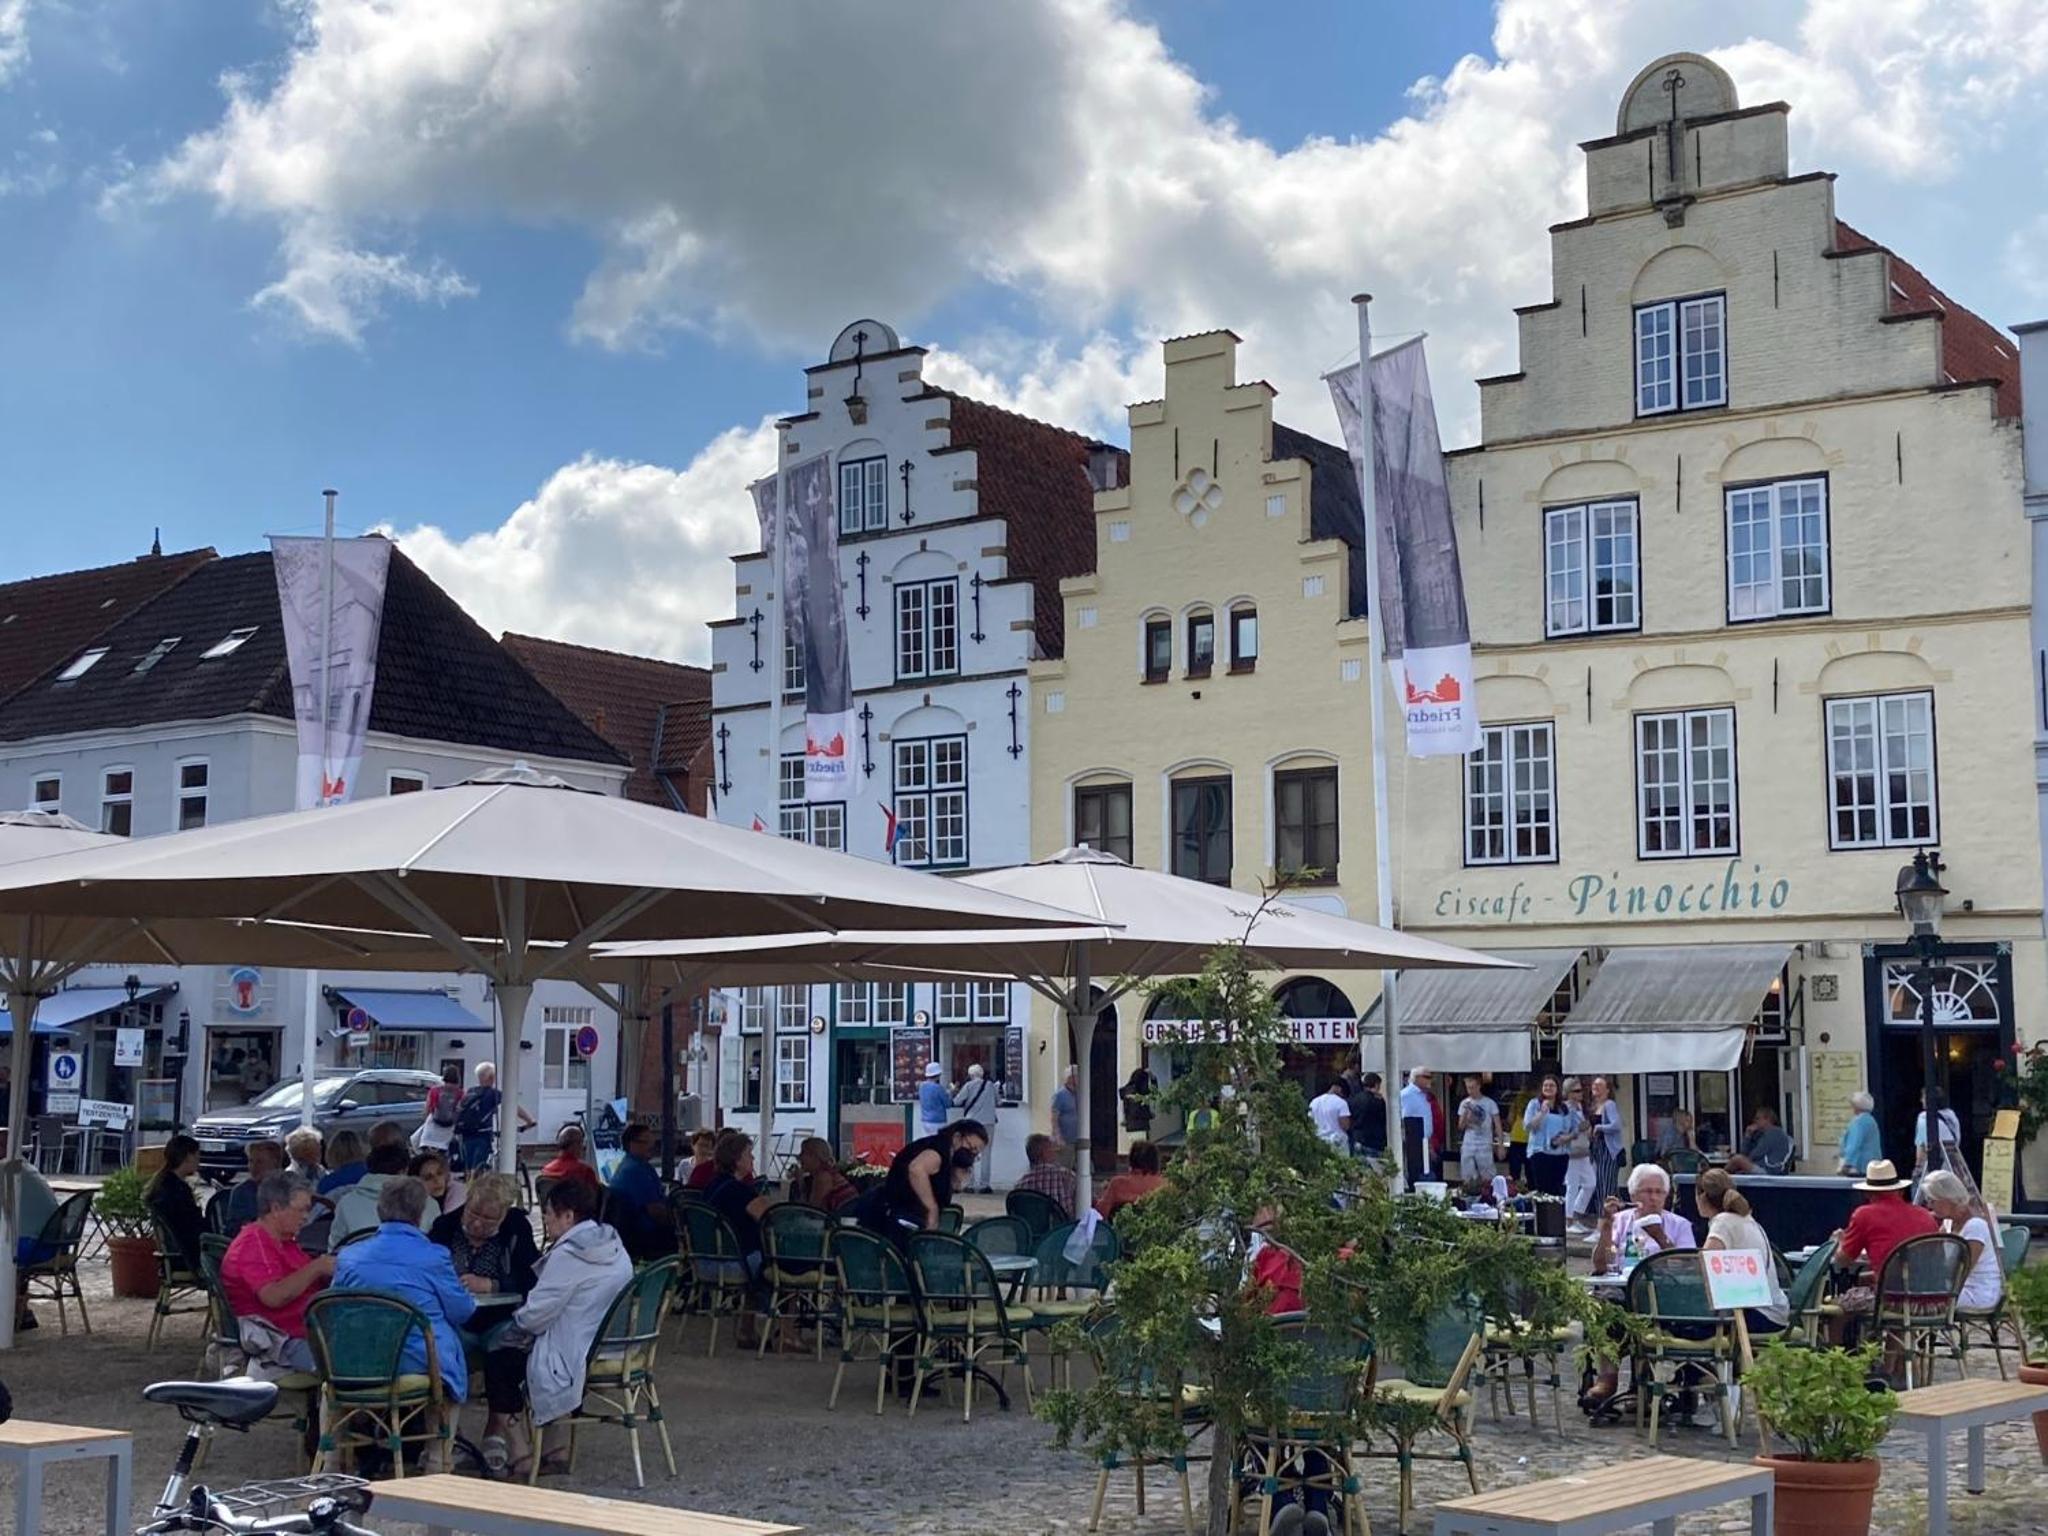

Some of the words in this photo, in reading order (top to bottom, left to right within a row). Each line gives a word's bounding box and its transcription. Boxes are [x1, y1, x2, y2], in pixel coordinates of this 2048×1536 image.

[1435, 882, 1532, 922] Eiscafe
[1568, 858, 1791, 915] Pinocchio
[1270, 1021, 1356, 1040] HRTEN
[82, 1107, 129, 1120] TESTZENTR
